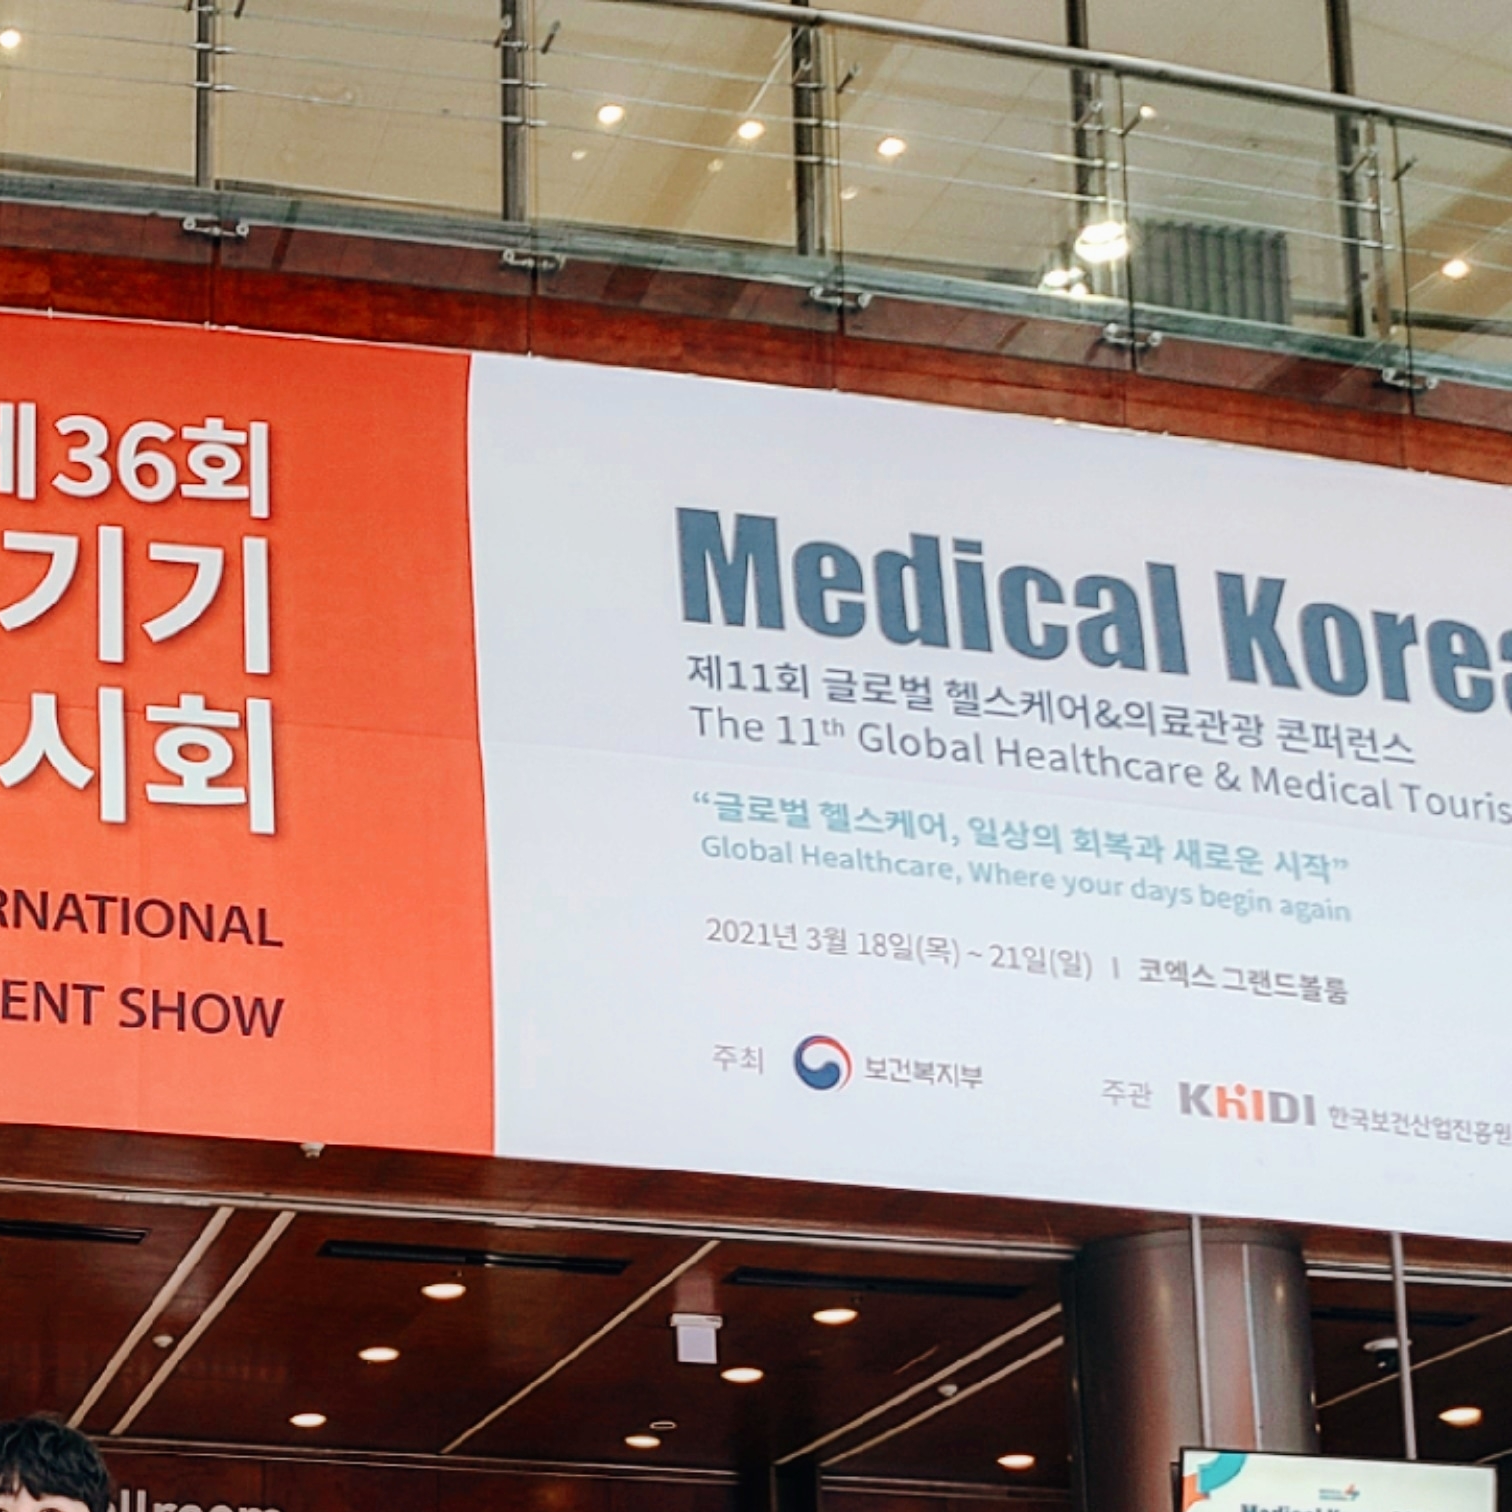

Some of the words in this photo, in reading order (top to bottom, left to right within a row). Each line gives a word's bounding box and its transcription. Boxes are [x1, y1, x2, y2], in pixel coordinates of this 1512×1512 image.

[676, 507, 1189, 675] Medical
[1215, 571, 1512, 723] Kore
[688, 655, 809, 698] 제11회
[823, 668, 933, 712] 글로벌
[944, 678, 1265, 748] 헬스케어&의료관광
[1276, 718, 1416, 765] 콘퍼런스
[690, 706, 764, 743] The
[777, 715, 845, 748] 11th
[859, 723, 984, 765] Global
[996, 737, 1204, 788] Healthcare
[1215, 761, 1242, 793] &
[1252, 765, 1393, 811] Medical
[819, 802, 961, 847] 헬스케어,
[968, 817, 1062, 854] 일상의
[1073, 826, 1165, 864] 회복과
[1174, 839, 1264, 876] 새로운
[701, 835, 793, 864] Global
[802, 844, 962, 885] Healthcare,
[968, 861, 1056, 891] Where
[1061, 872, 1123, 901] your
[1131, 879, 1194, 908] days
[1199, 884, 1272, 917] begin
[1280, 894, 1351, 924] again
[705, 917, 798, 951] 2021년
[806, 927, 848, 956] 3월
[858, 932, 960, 969] 18일(목)
[990, 944, 1092, 981] 21일(일)
[1139, 957, 1217, 990] 코엑스
[1222, 966, 1349, 1006] 그랜드볼룸
[119, 987, 285, 1038] SHOW
[713, 1044, 765, 1075] 주최
[864, 1056, 984, 1090] 보건복지부
[1102, 1079, 1154, 1110] 주관
[1178, 1081, 1317, 1127] KHIDI
[1329, 1105, 1512, 1147] 한국보건산업진흥원
